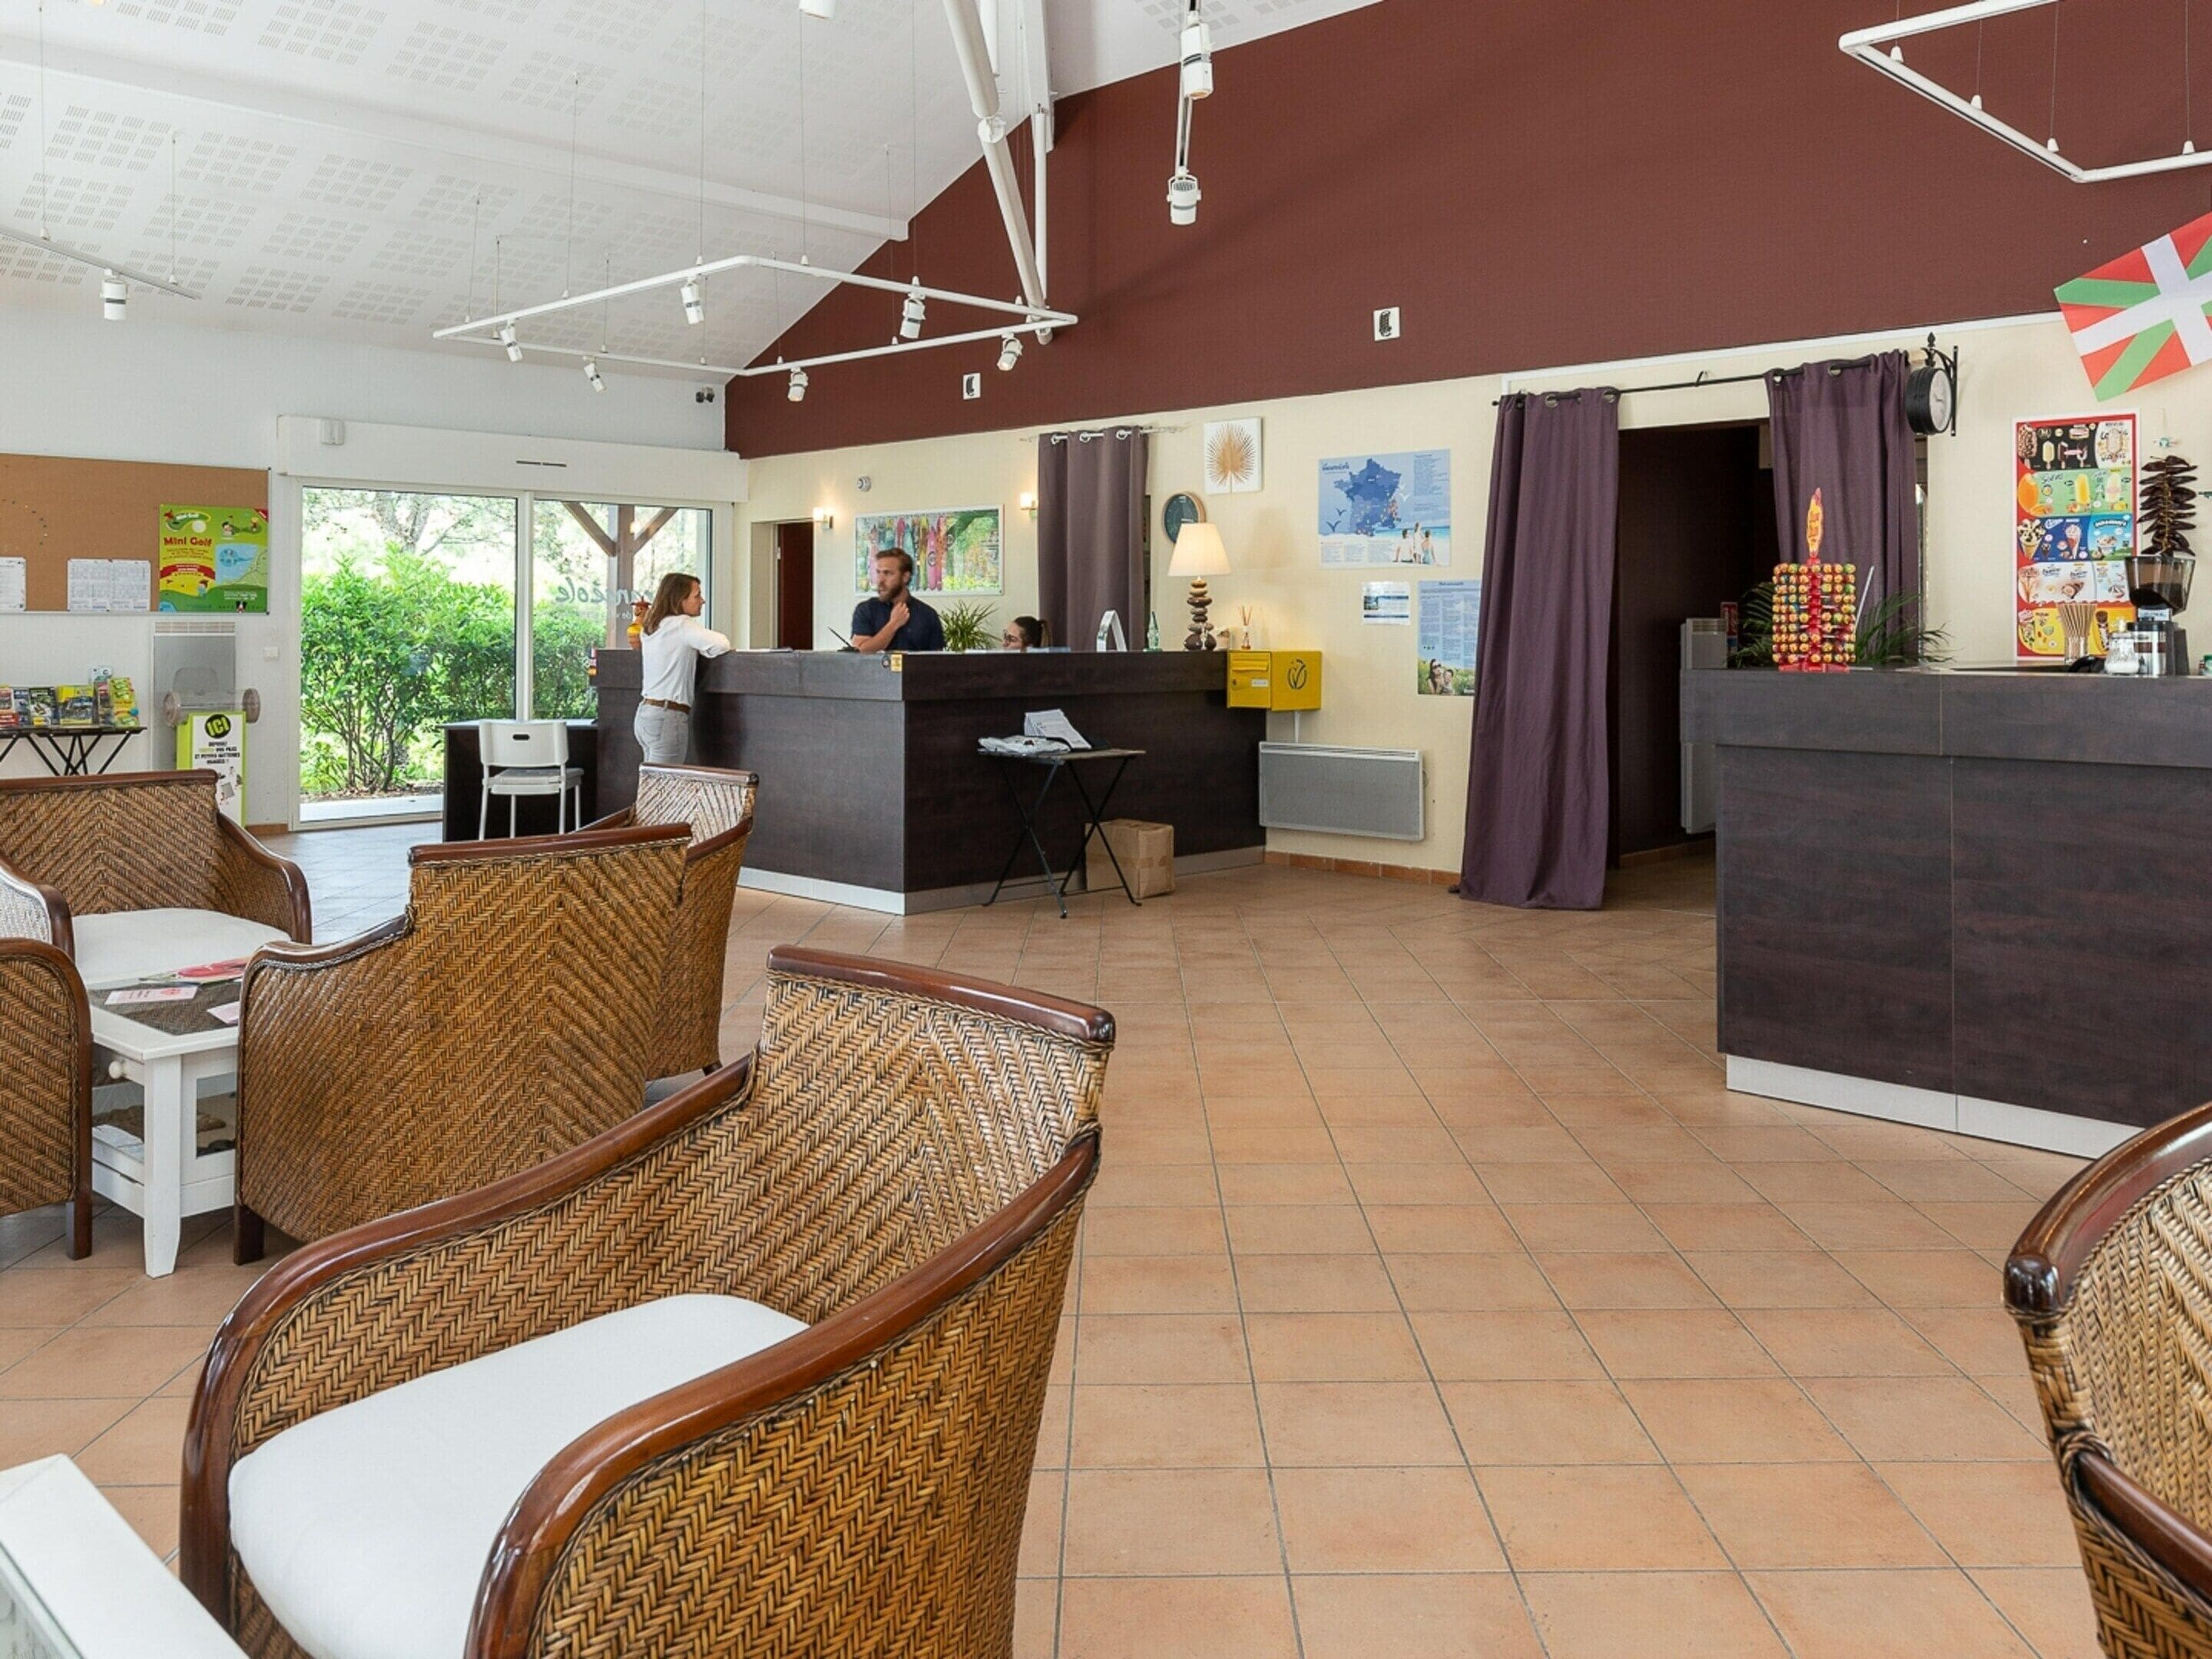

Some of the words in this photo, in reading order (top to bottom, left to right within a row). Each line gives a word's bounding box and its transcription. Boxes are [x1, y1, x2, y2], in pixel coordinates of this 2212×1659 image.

[164, 536, 187, 546] Mini
[190, 536, 213, 547] Golf
[207, 717, 230, 737] ICI
